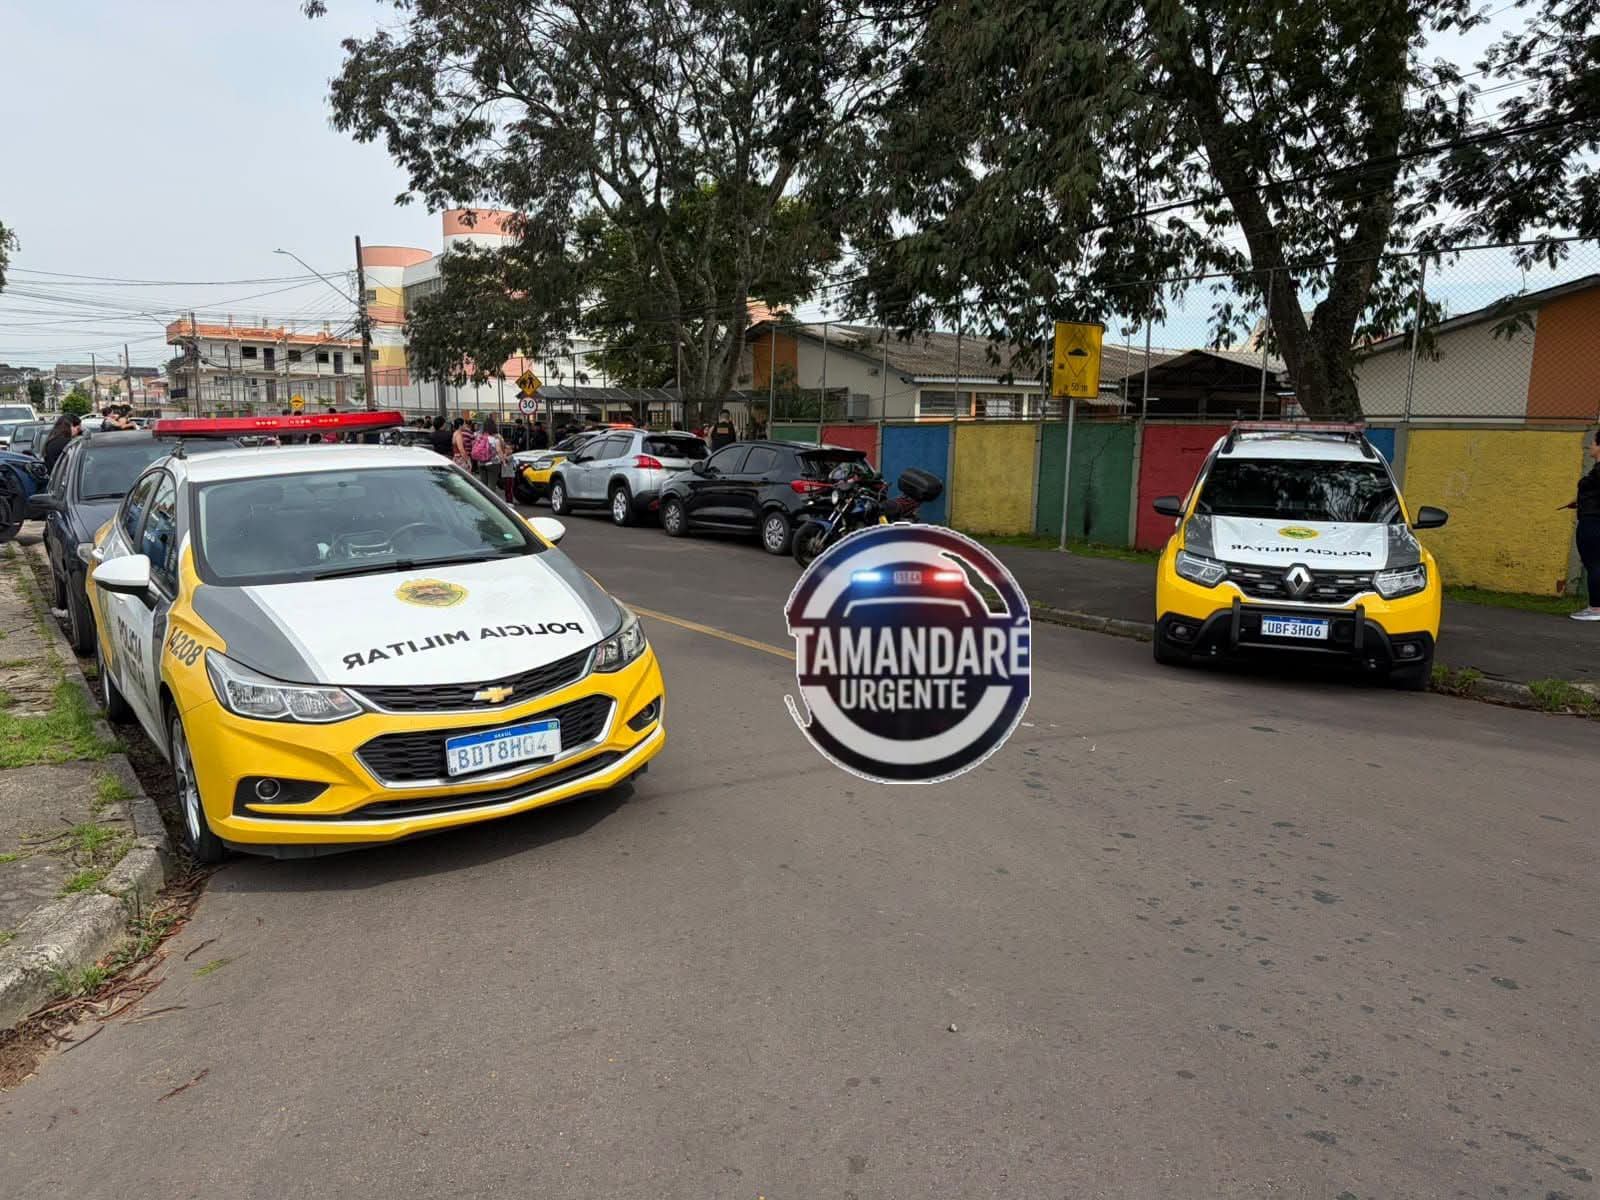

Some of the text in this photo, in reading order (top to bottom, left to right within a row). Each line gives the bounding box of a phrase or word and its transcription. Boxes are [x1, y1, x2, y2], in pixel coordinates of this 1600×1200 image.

[523, 400, 535, 409] 30
[1267, 622, 1321, 637] UBF3H06
[166, 626, 204, 667] 14208
